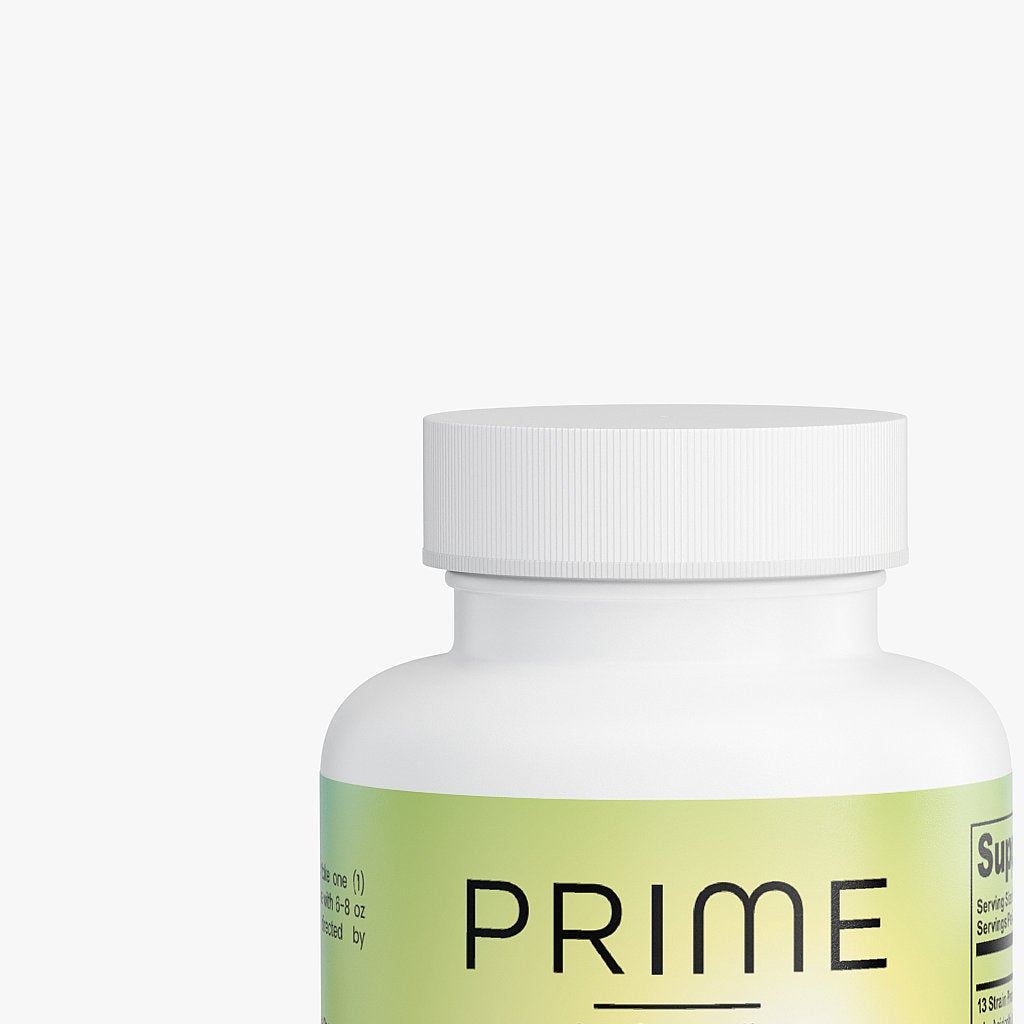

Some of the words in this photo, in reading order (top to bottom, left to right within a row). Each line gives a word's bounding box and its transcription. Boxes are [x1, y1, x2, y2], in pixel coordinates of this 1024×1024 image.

[352, 869, 365, 896] (1)
[335, 896, 350, 915] 6-8
[354, 904, 365, 919] oz
[352, 925, 365, 951] by
[466, 878, 888, 975] PRIME
[978, 997, 987, 1013] 13
